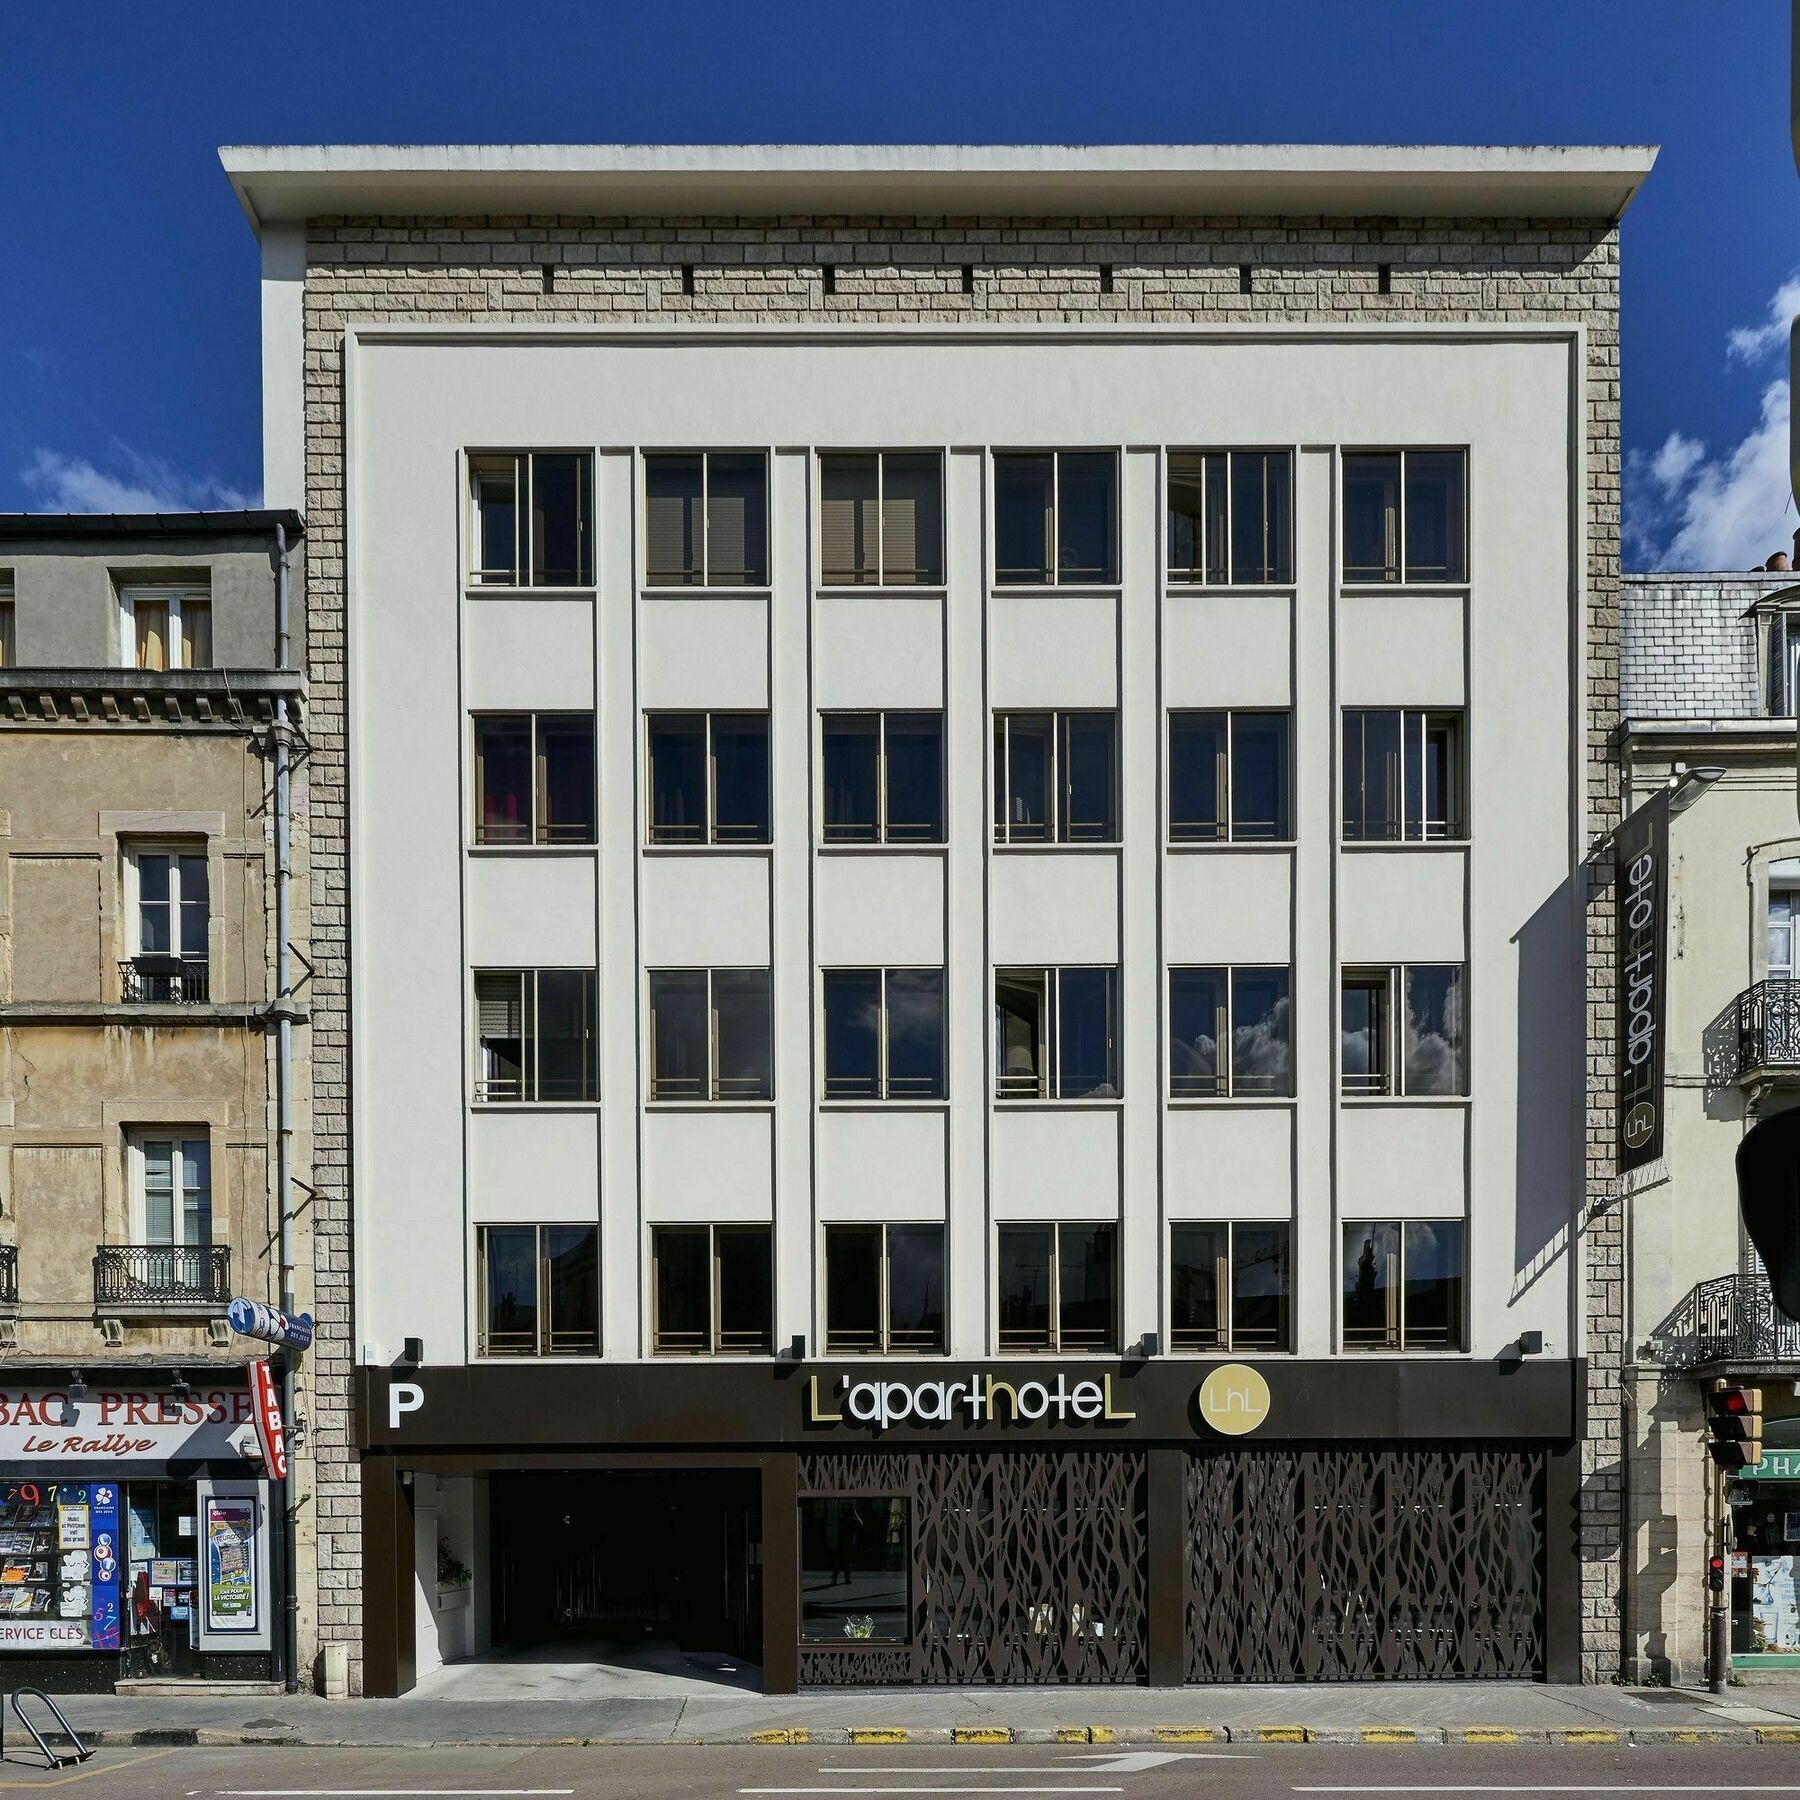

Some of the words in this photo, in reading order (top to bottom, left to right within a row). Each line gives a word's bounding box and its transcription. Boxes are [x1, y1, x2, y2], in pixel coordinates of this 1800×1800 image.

[97, 1391, 253, 1426] PRESSE
[389, 1383, 424, 1428] P
[1208, 1386, 1262, 1412] LhL
[262, 1366, 287, 1475] TABAC
[22, 1435, 59, 1453] Le
[61, 1434, 157, 1457] Rallye
[20, 1484, 40, 1506] 9
[47, 1485, 57, 1502] 7
[78, 1490, 87, 1504] 2
[107, 1602, 114, 1612] 2
[50, 1624, 83, 1640] CLÉS
